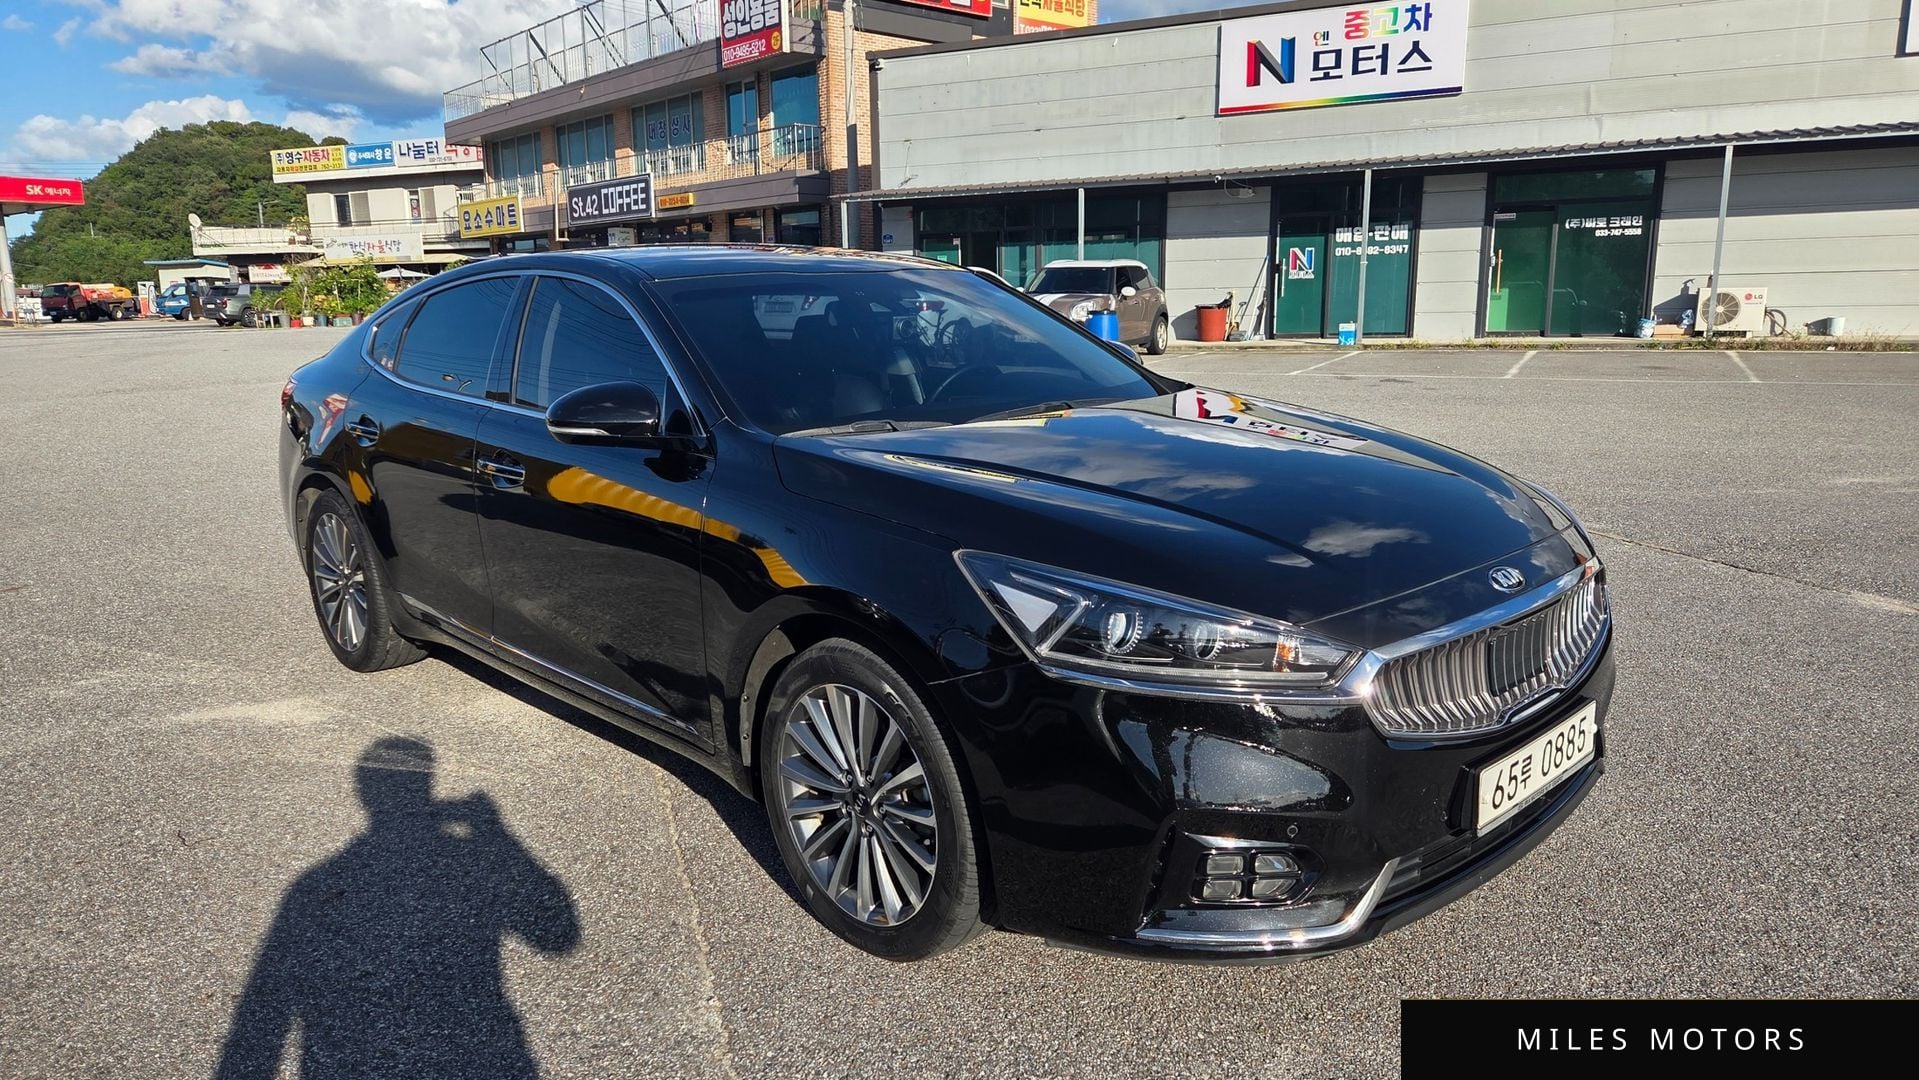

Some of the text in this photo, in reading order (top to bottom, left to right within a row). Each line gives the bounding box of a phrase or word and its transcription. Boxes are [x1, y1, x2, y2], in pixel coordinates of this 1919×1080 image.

[722, 0, 780, 39] 성인용품
[1344, 3, 1432, 40] 중고차
[1313, 30, 1330, 46] 엔
[1246, 36, 1296, 87] N
[1310, 40, 1433, 82] 모터스
[398, 140, 439, 160] 나눔터
[26, 184, 43, 196] SK
[572, 194, 600, 218] St.42
[600, 182, 647, 215] COFFEE
[463, 203, 518, 231] 요소수마트
[1608, 215, 1643, 227] 크레인
[1290, 248, 1315, 271] N
[1335, 244, 1409, 257] 010-892-8347
[1491, 568, 1523, 587] KIA
[1492, 755, 1533, 810] 65루
[1541, 715, 1587, 777] 0885
